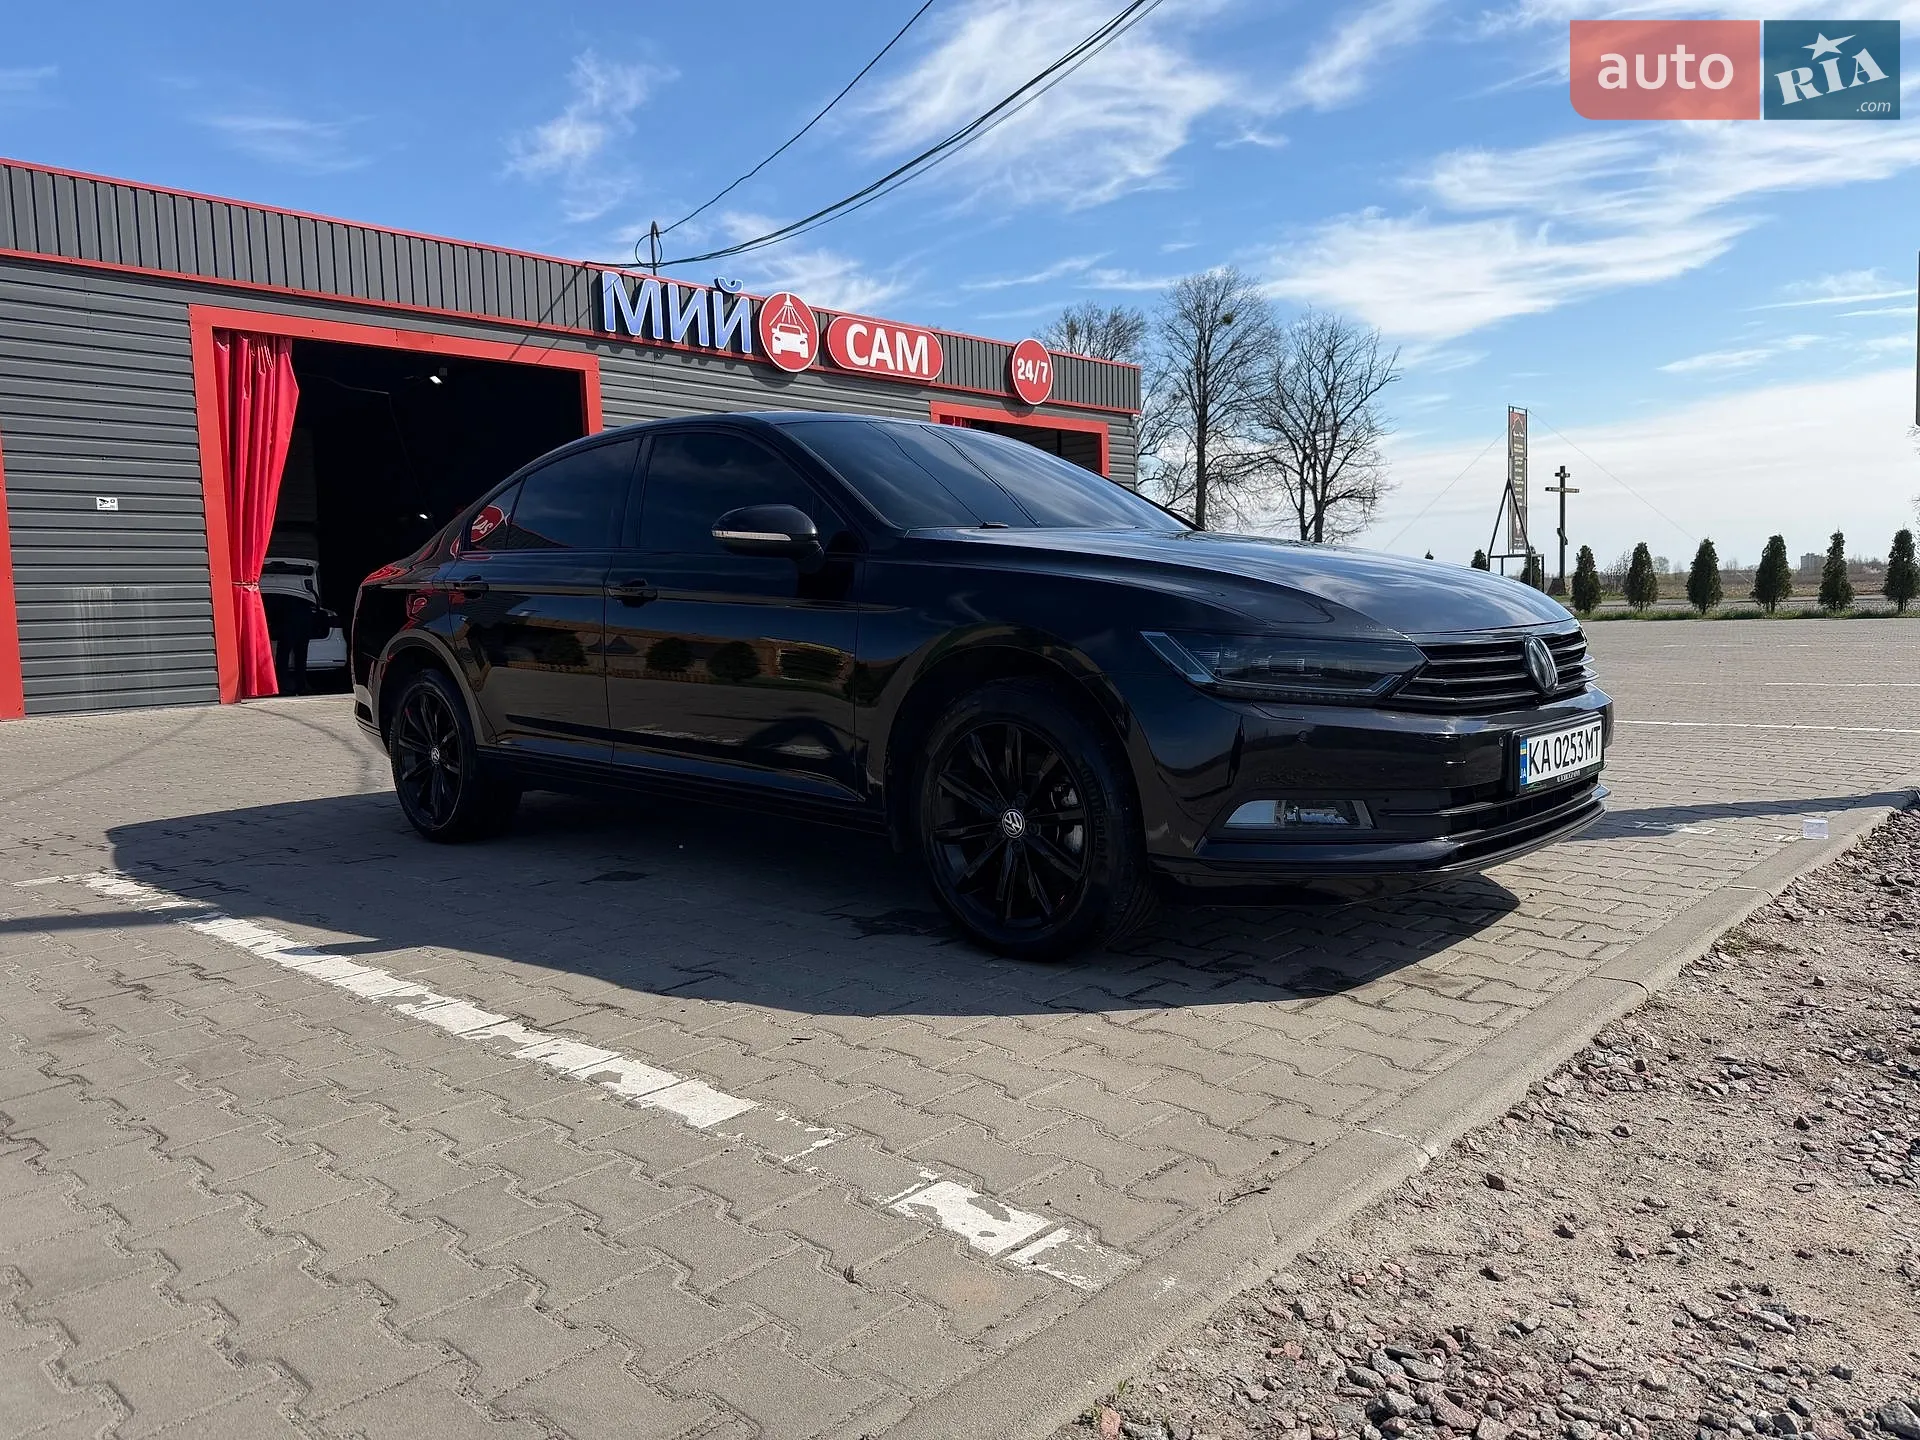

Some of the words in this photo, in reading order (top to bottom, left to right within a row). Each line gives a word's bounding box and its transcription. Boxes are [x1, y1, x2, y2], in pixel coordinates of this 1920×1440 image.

[601, 270, 753, 354] МИЙ
[845, 322, 929, 376] САМ
[1017, 358, 1048, 384] 24/7
[1529, 740, 1551, 777] KA
[1554, 730, 1584, 769] 0253
[1585, 725, 1601, 760] MT
